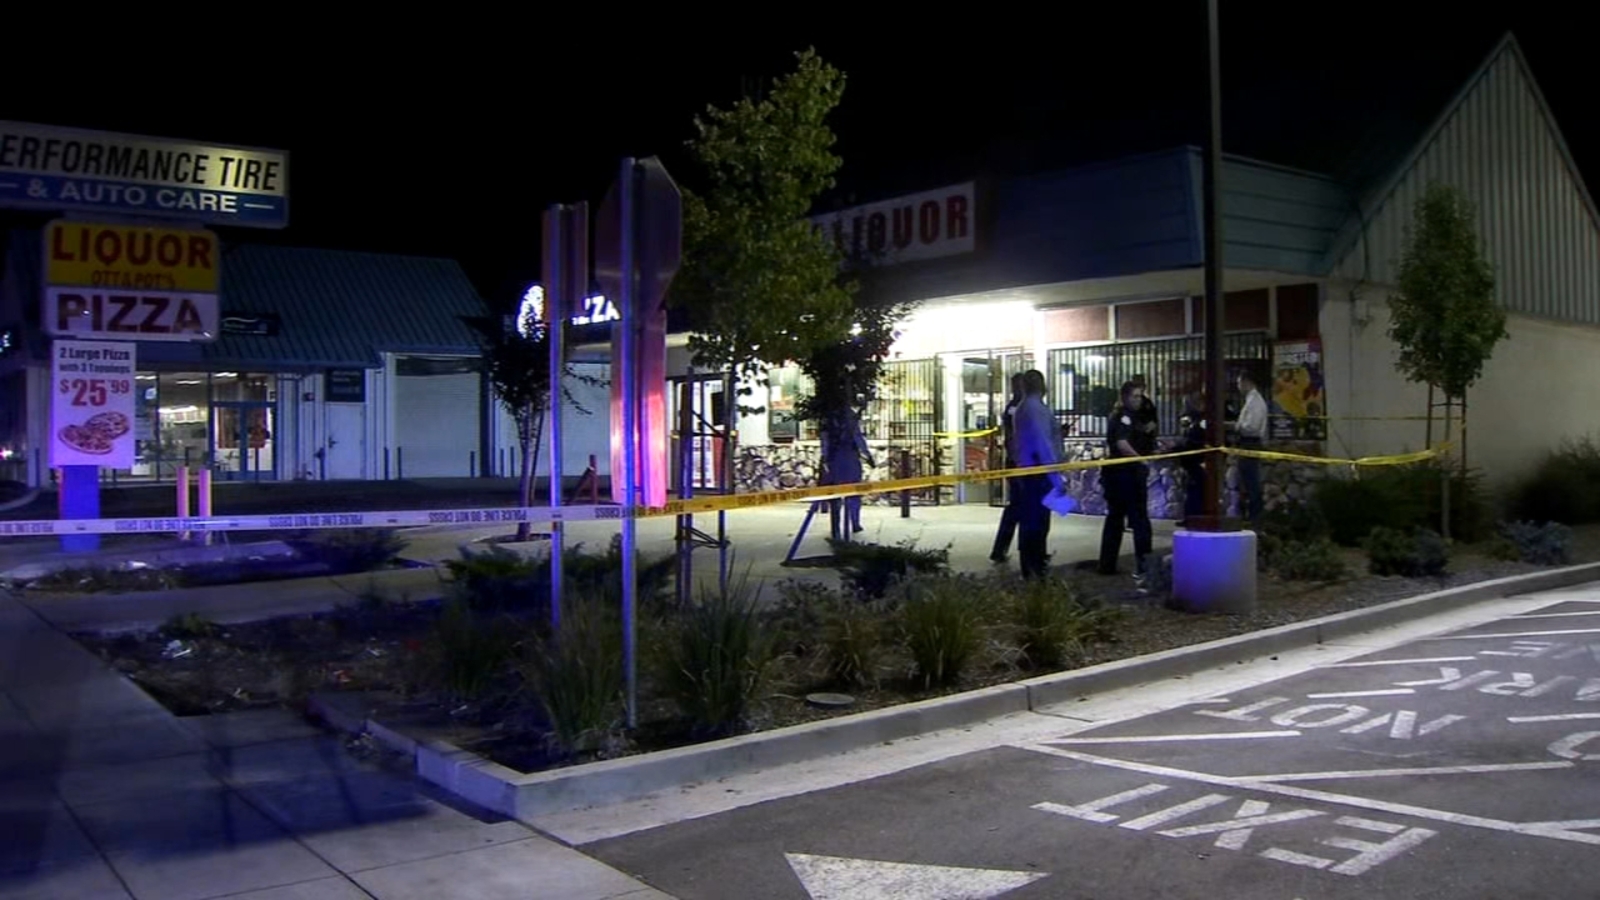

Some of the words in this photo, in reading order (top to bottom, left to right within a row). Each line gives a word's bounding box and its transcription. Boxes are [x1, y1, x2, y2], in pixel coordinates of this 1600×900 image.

[219, 156, 279, 190] TIRE
[26, 177, 49, 198] &
[58, 180, 147, 206] AUTO
[156, 189, 238, 213] CARE
[53, 226, 211, 270] LIQUOR
[58, 294, 203, 333] PIZZA
[60, 347, 67, 358] 2
[69, 347, 101, 361] Large
[103, 348, 131, 361] Pizza
[1194, 697, 1467, 740] NOT
[1030, 783, 1440, 876] EXIT
